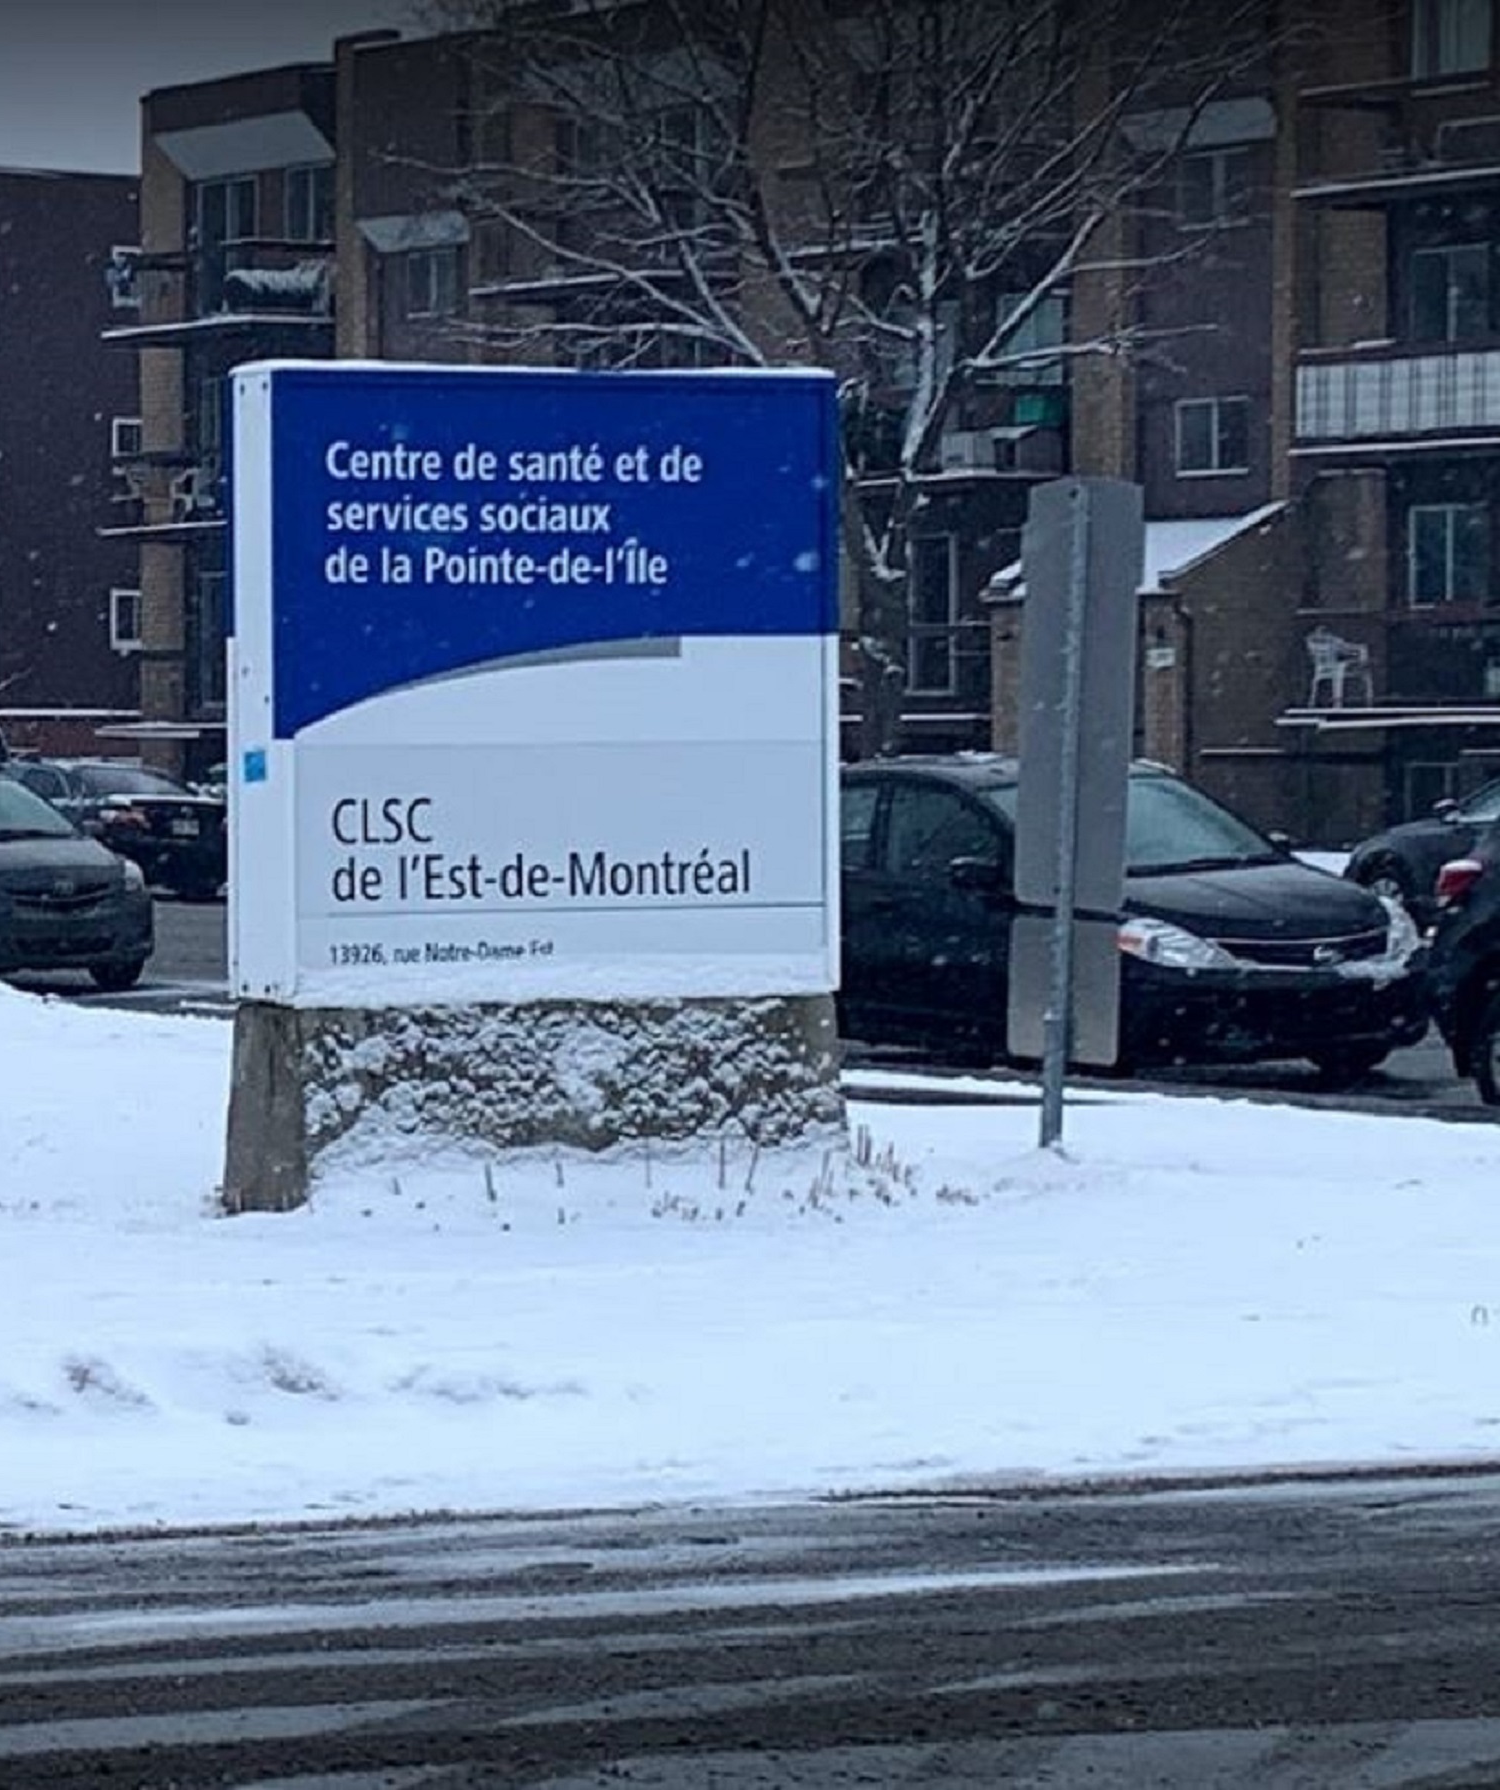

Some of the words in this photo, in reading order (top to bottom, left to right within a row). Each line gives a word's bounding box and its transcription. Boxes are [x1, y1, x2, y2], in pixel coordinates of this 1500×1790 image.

[326, 442, 441, 481] Centre
[454, 443, 497, 481] de
[509, 443, 604, 482] santé
[615, 447, 649, 482] et
[660, 445, 702, 483] de
[327, 496, 468, 532] services
[480, 496, 610, 532] sociaux
[325, 546, 369, 583] de
[382, 547, 411, 584] la
[425, 537, 668, 584] Pointe-de-l'Île
[331, 797, 433, 844] CLSC
[332, 856, 383, 902] de
[400, 848, 750, 900] l'Est-de-Montréal
[329, 943, 387, 966] 13926,
[393, 948, 420, 963] rue
[425, 941, 525, 963] Notre-Dame
